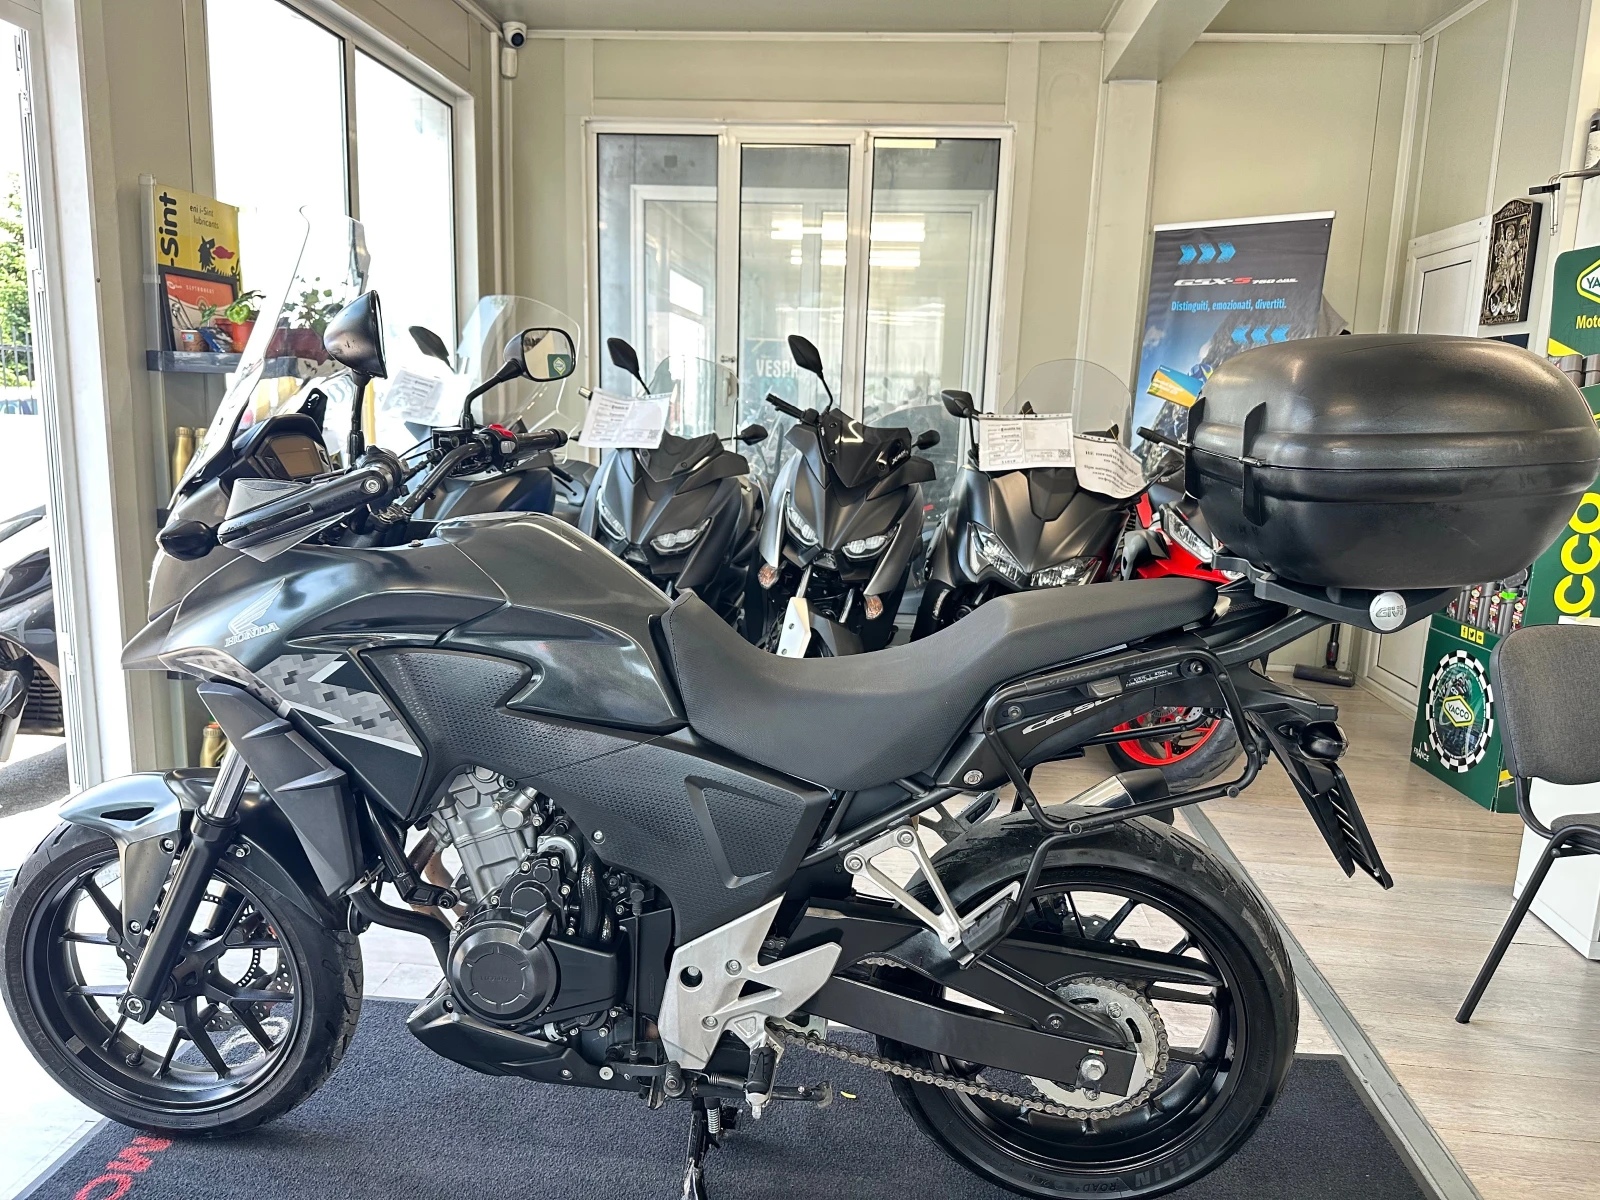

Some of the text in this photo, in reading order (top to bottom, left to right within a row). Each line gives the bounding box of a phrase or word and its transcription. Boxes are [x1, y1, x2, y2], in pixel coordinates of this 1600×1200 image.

[190, 205, 199, 213] eni
[193, 214, 219, 229] lubricants
[1174, 276, 1253, 286] GSX-S
[1171, 297, 1287, 313] Distinguiti, emozionati, divertiti.
[1554, 492, 1600, 619] CCO
[1376, 605, 1403, 617] GIVI
[224, 622, 280, 648] HONDA
[1447, 702, 1470, 720] YACCO
[1083, 1182, 1117, 1192] ROAD
